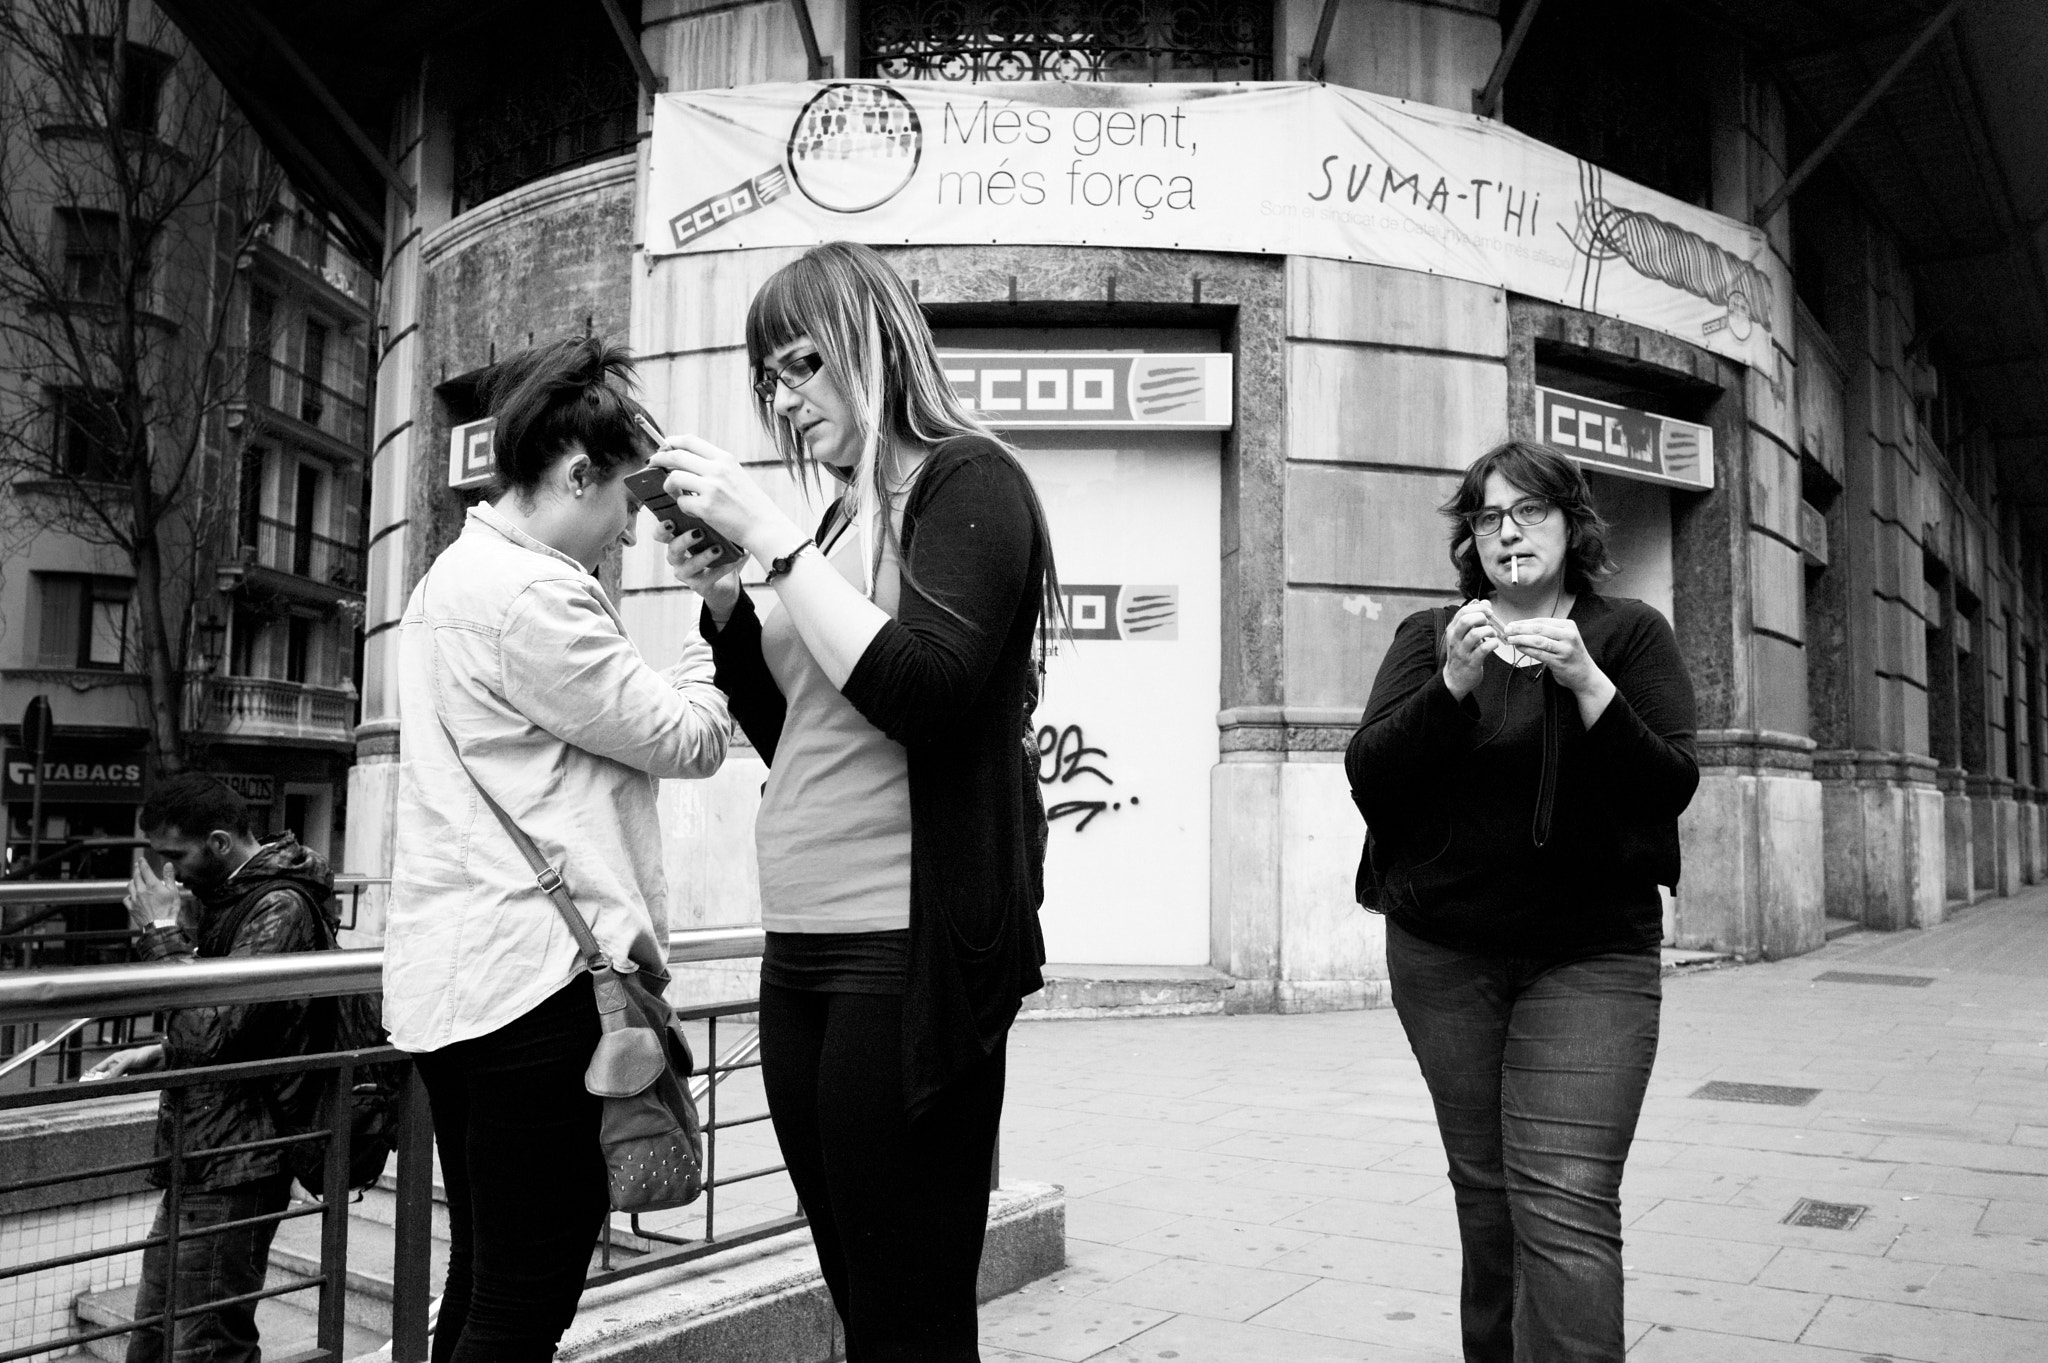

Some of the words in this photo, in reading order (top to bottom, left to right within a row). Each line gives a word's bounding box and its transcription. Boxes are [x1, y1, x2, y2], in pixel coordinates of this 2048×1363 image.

[943, 100, 1052, 144] Més
[1072, 105, 1197, 155] gent,
[674, 187, 753, 241] CCOO
[938, 158, 1046, 206] més
[1066, 160, 1196, 220] força
[1260, 199, 1297, 216] Som
[1302, 204, 1316, 219] el
[1320, 206, 1376, 227] sindicat
[1379, 215, 1399, 230] de
[43, 763, 140, 781] TABACS
